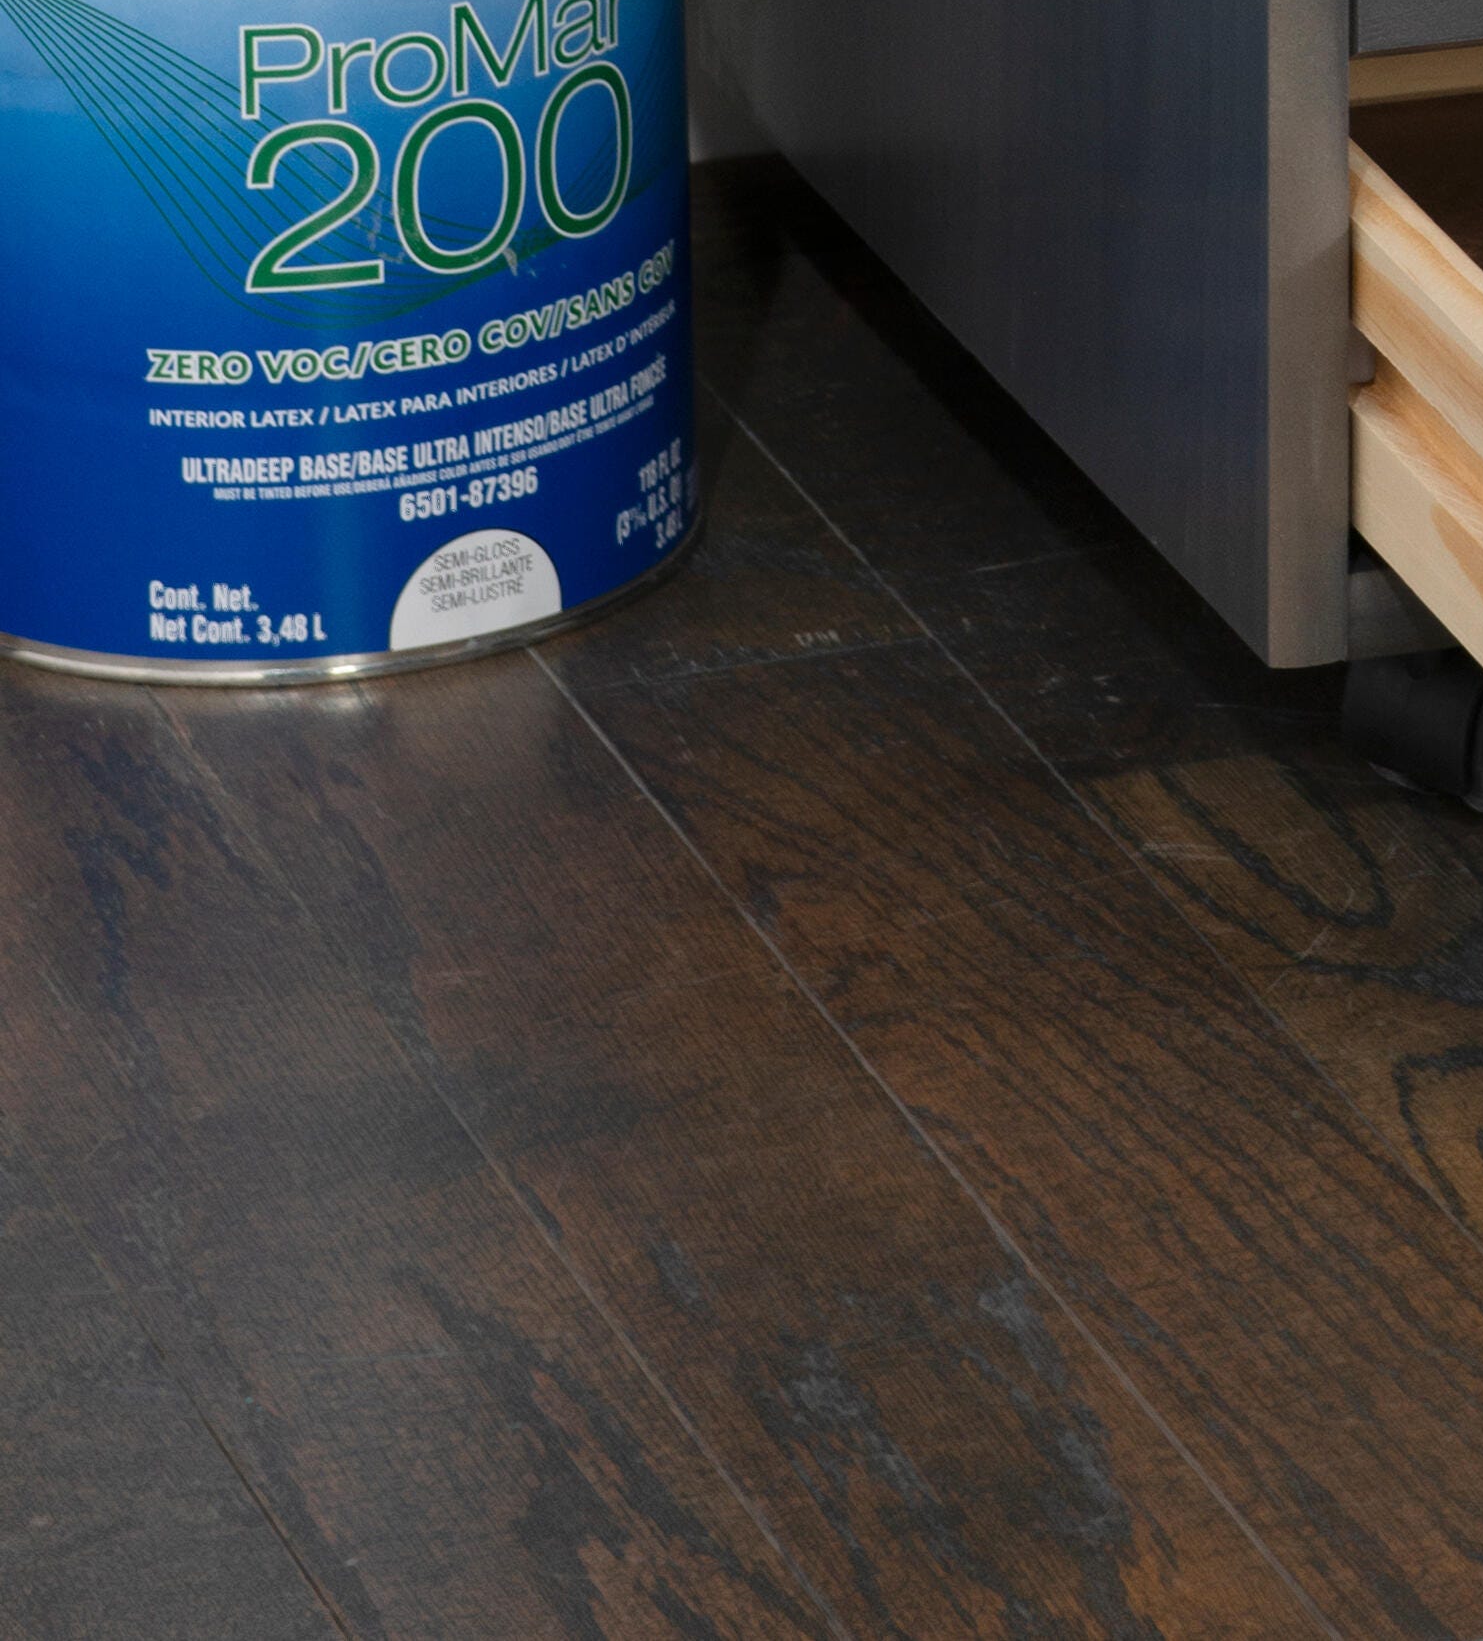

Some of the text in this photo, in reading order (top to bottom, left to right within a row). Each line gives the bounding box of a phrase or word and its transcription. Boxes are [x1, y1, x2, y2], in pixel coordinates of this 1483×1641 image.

[245, 60, 633, 294] 200
[145, 238, 675, 385] ZERO VOC/CERO COV/SANS COV
[149, 408, 246, 429] INTERIOR
[250, 408, 314, 428] LATEX
[334, 399, 396, 424] LATEX
[401, 391, 453, 416] PARA
[455, 363, 559, 406] INTERIORES
[571, 344, 614, 373] LATEX
[181, 351, 667, 484] ULTRADEEP BASE/BASE ULTRA INTENSO/BASE ULTRA FONCÉE
[400, 465, 538, 522] 6501-87396
[420, 554, 534, 596] SEMI-BRILLANTE
[434, 538, 520, 572] SEMI-GLOSS
[149, 579, 259, 612] Cont. Net.
[430, 575, 525, 613] SEMI-LUSTRÉ
[149, 612, 328, 647] Net Cont. 3,48 L
